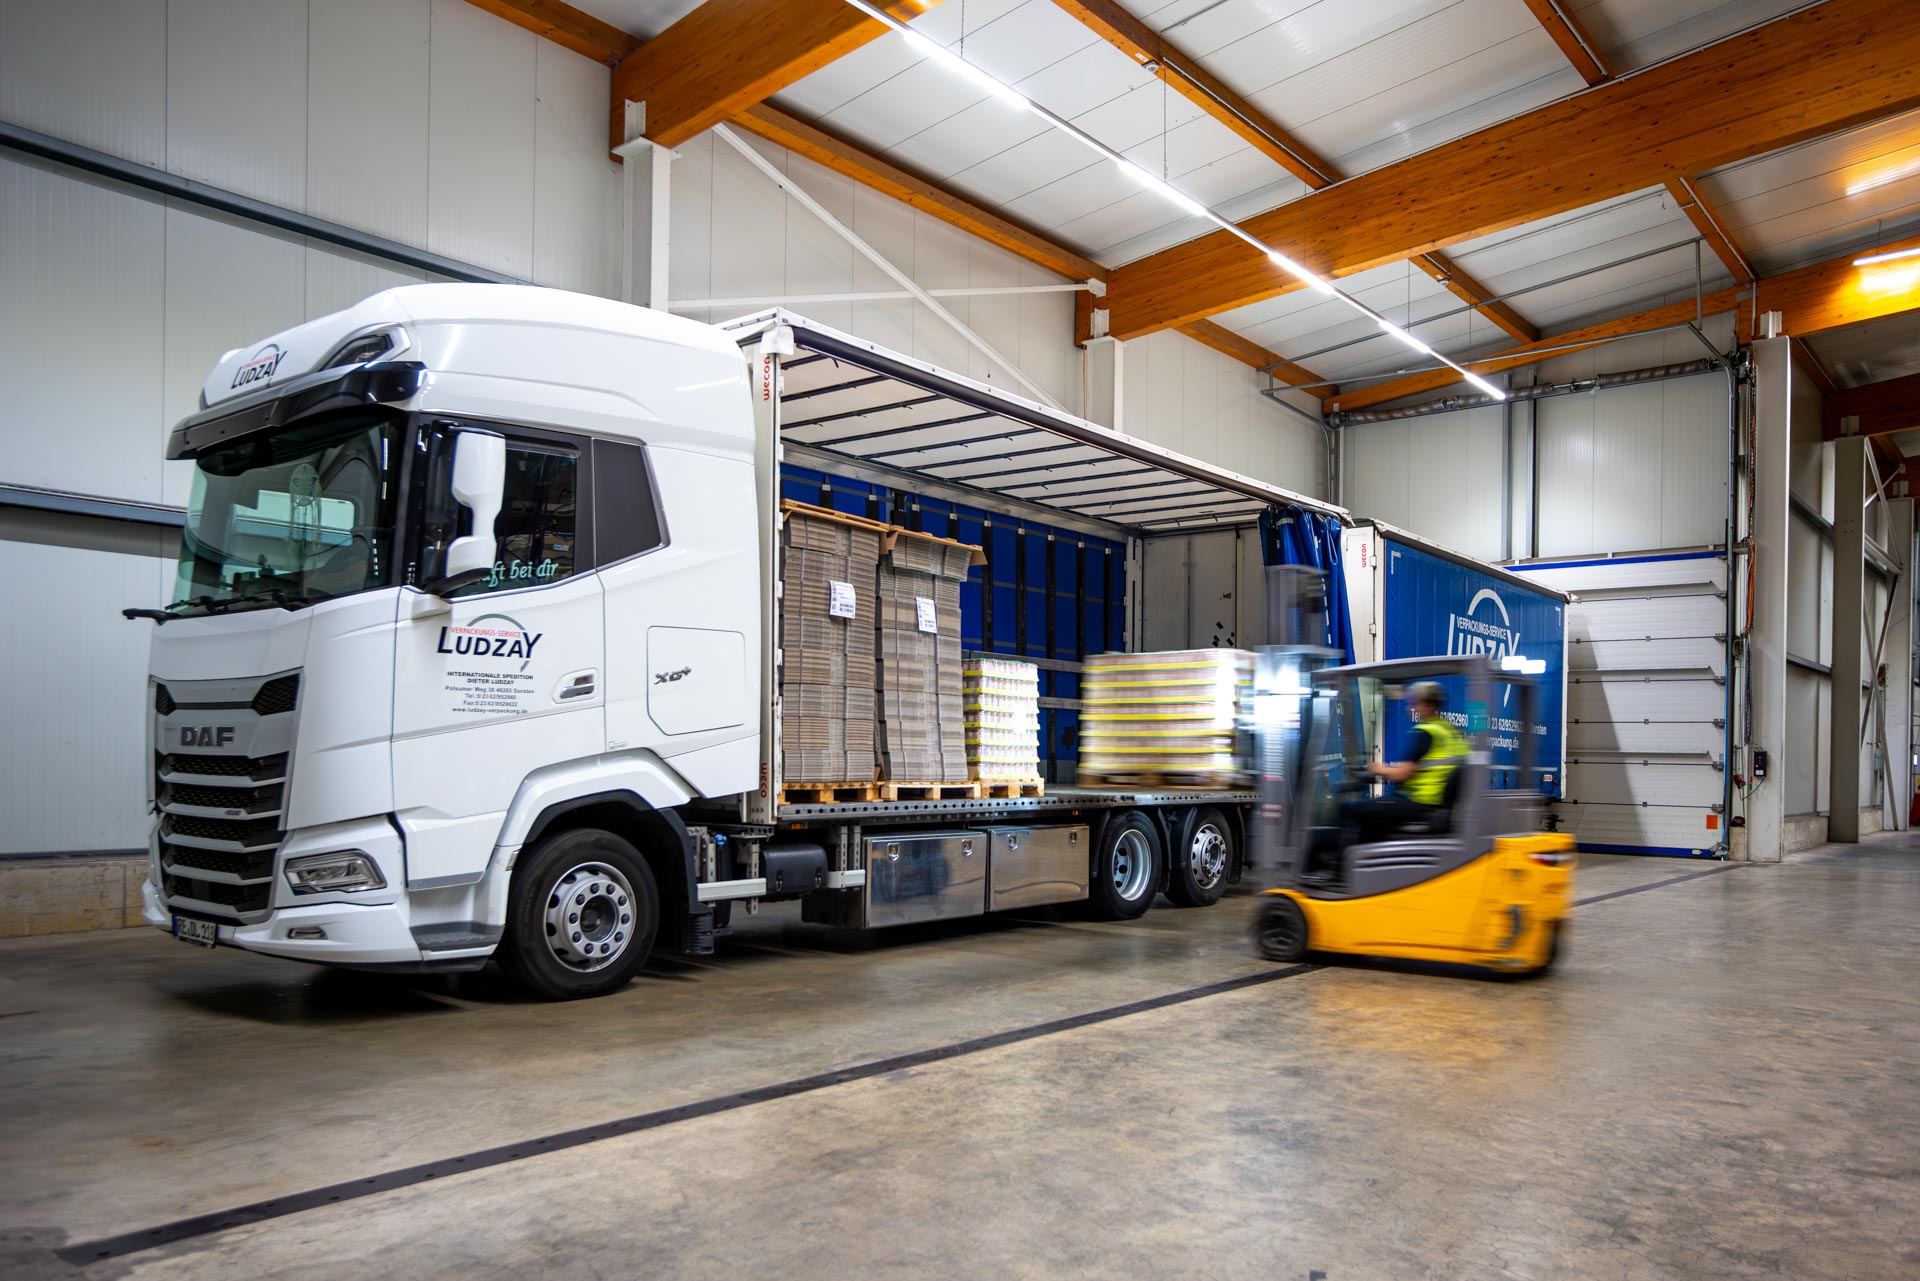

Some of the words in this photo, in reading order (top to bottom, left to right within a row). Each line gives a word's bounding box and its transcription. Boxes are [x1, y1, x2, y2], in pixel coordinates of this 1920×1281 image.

[231, 350, 287, 389] LUDZAY
[763, 355, 771, 401] wecon
[509, 559, 533, 579] bei
[536, 558, 559, 577] dir
[451, 626, 521, 639] VERPACKUNGS-SERVICE
[1456, 615, 1507, 640] VERPACKUNGS-SERVICE
[437, 626, 543, 658] LUDZAY
[447, 671, 500, 679] INTERNATIONALE
[181, 726, 235, 747] DAF
